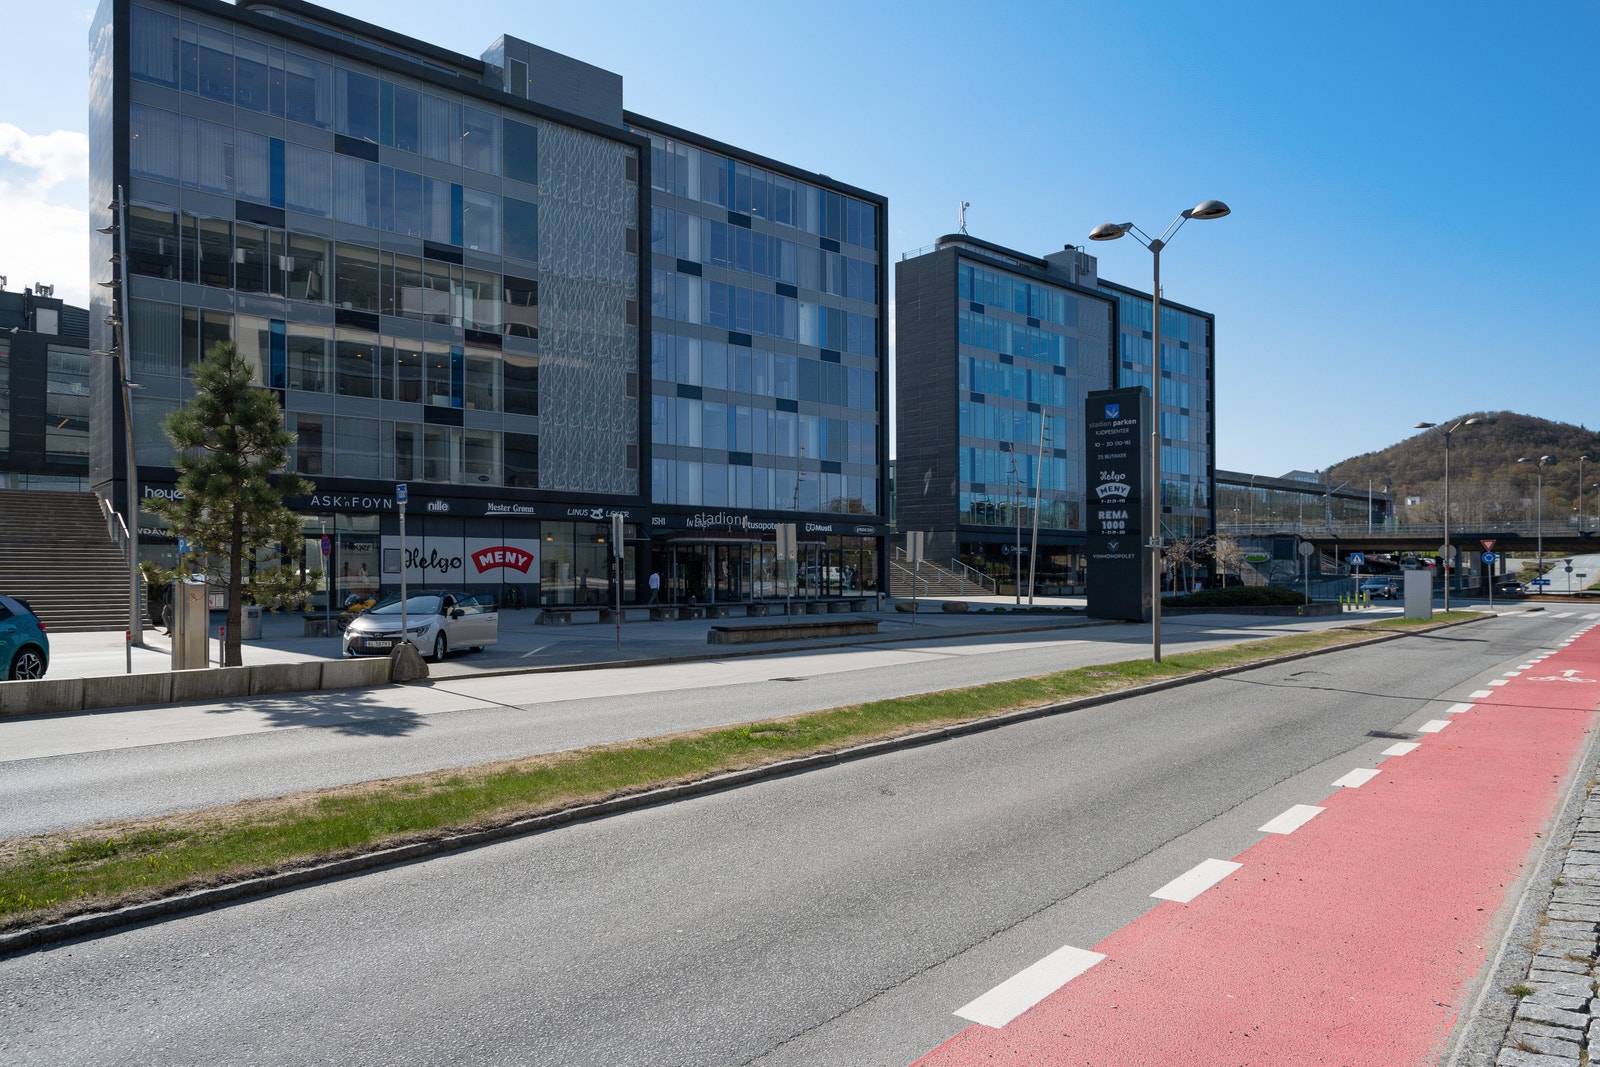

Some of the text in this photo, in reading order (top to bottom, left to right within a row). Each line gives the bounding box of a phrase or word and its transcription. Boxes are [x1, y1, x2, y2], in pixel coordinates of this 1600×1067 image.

[1112, 418, 1136, 427] parken
[144, 485, 186, 502] høye
[1100, 485, 1126, 495] MENY
[428, 500, 449, 511] nille
[487, 502, 511, 512] Mester
[567, 507, 588, 517] LINUS
[1098, 510, 1128, 520] REMA
[694, 511, 741, 526] stadion
[815, 524, 833, 533] Musti
[1101, 520, 1125, 530] 1000
[479, 551, 528, 568] MENY
